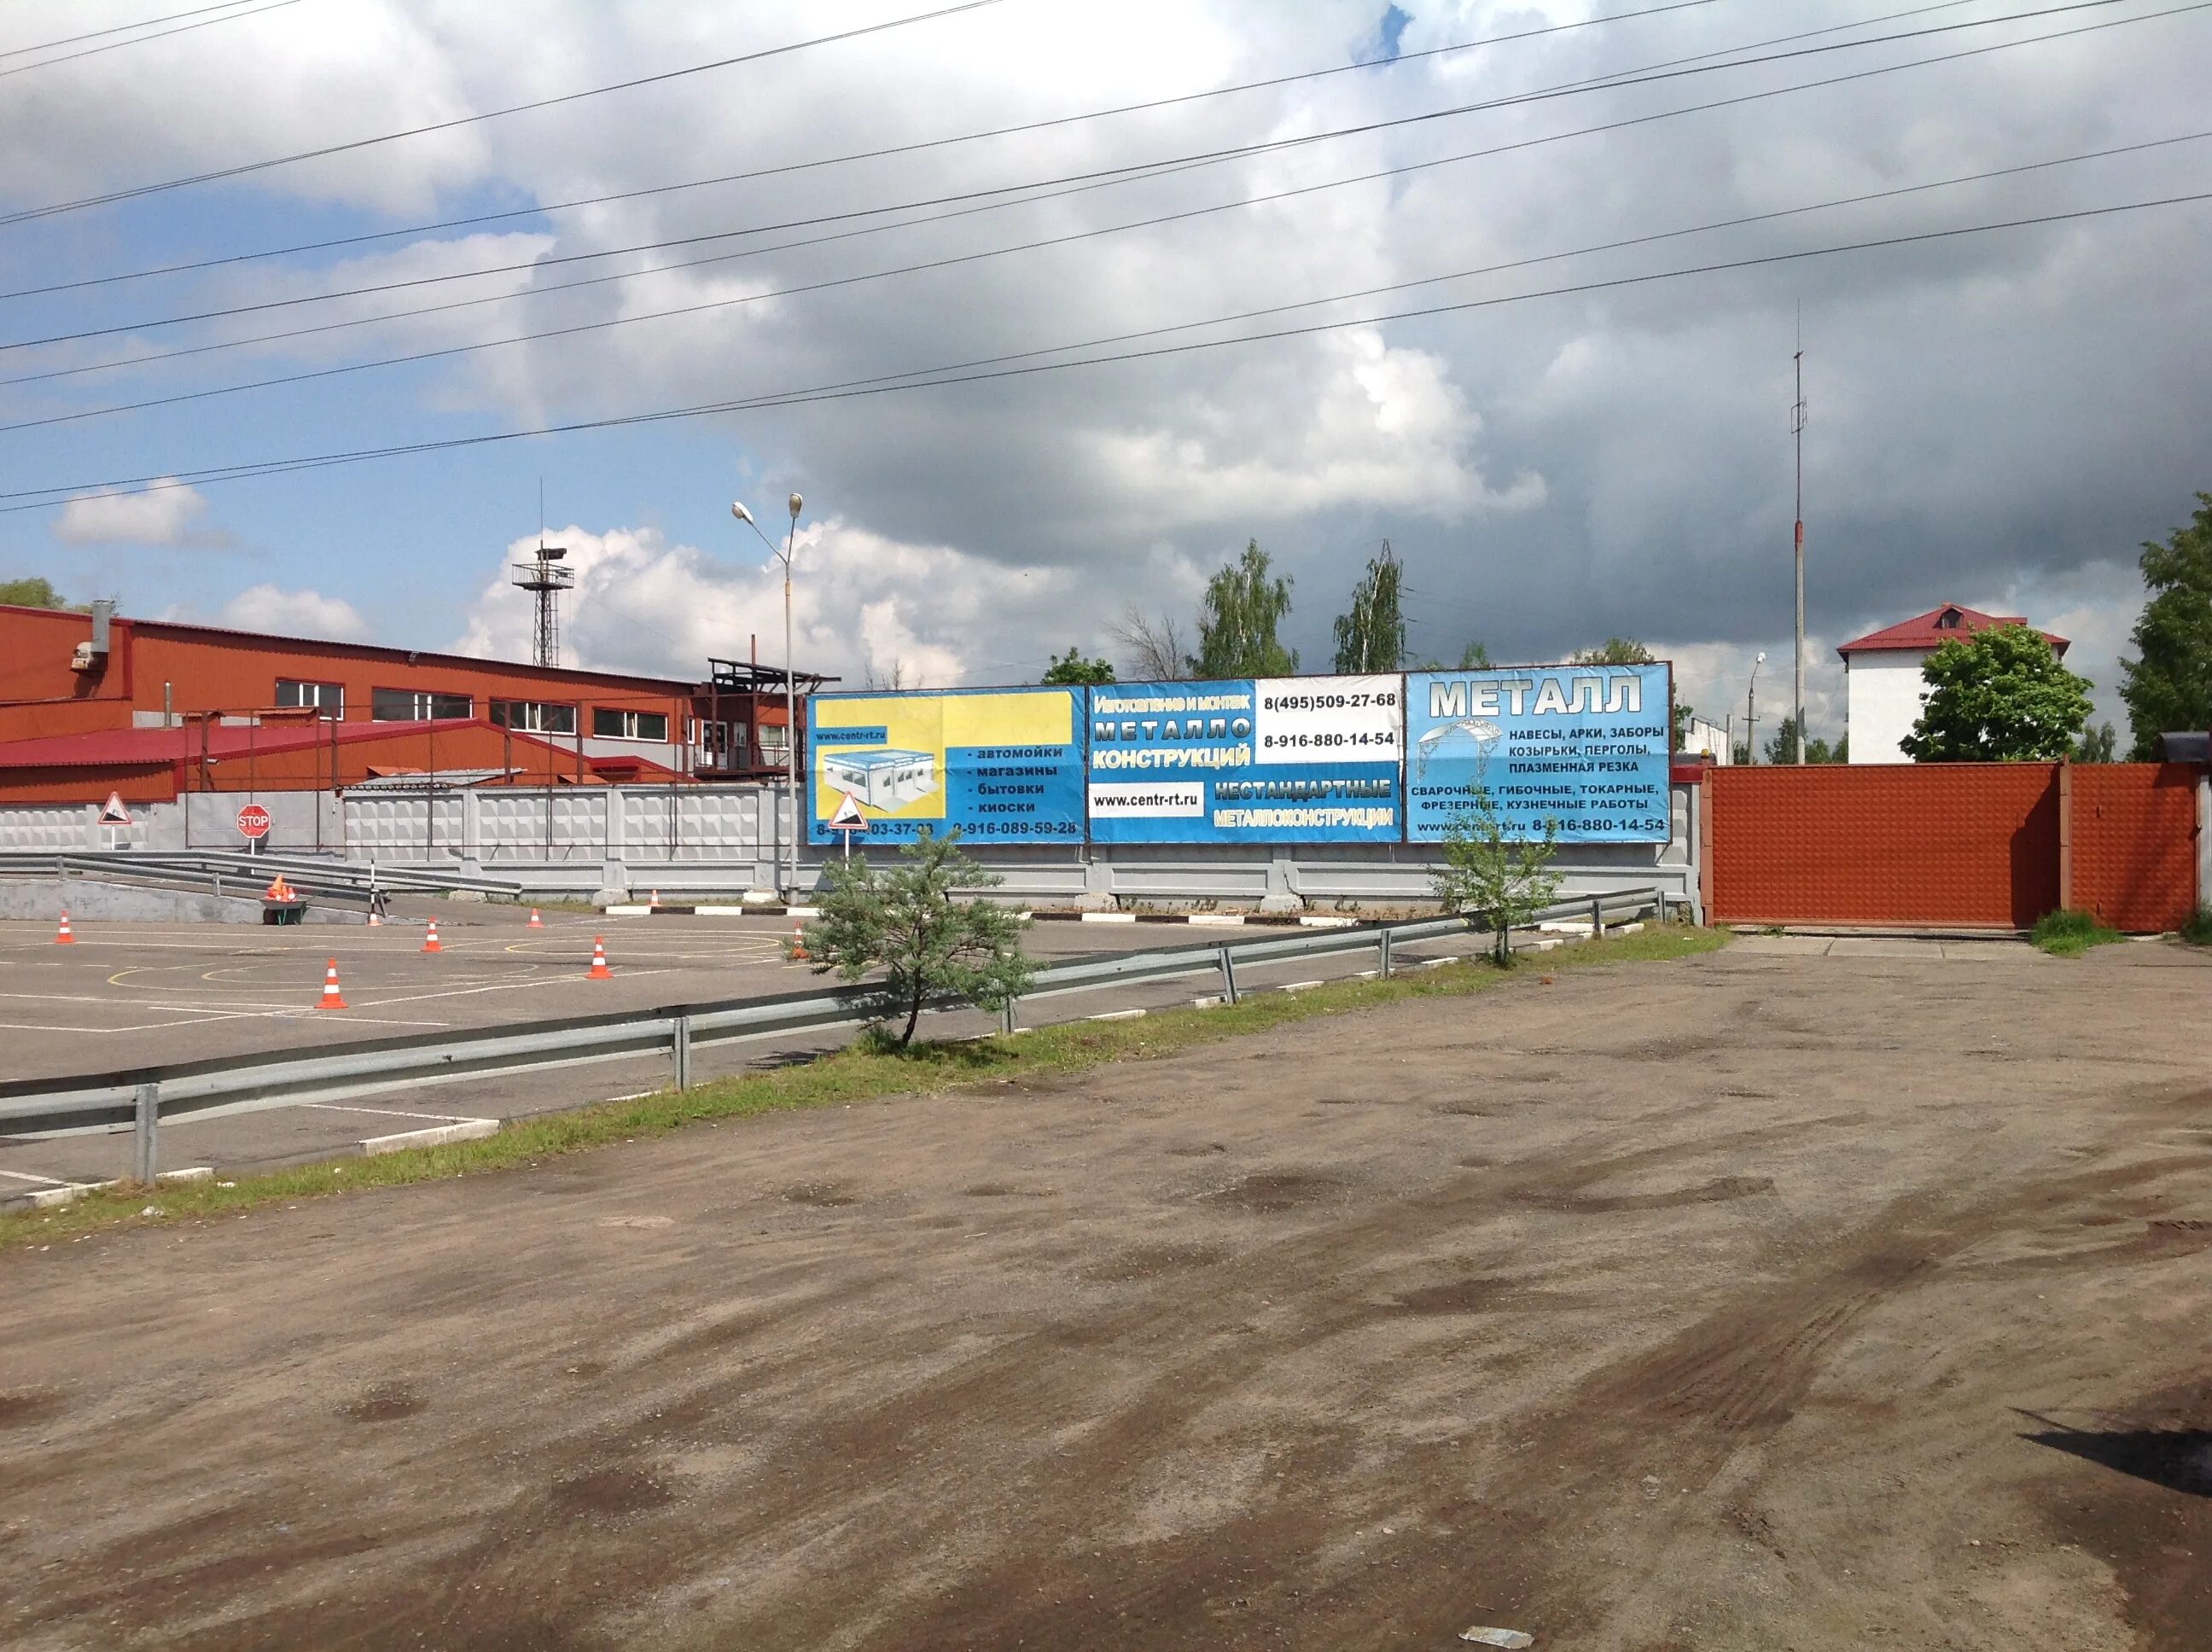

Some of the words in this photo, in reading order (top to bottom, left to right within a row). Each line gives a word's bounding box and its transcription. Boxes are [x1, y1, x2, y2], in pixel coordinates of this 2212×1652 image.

[1264, 693, 1396, 713] 8(495)509-27-68
[1429, 675, 1642, 718] МЕТАЛЛ
[1094, 695, 1185, 713] Изготовление
[1187, 697, 1195, 711] и
[1197, 695, 1250, 710] монтаж
[816, 731, 886, 741] www.centr-rt.ru
[1095, 718, 1251, 742] МЕТАЛЛО
[1509, 728, 1566, 741] НАВЕСЫ,
[1569, 728, 1607, 740] АРКИ,
[1610, 726, 1664, 738] ЗАБОРЫ
[1264, 732, 1394, 748] 8-916-880-14-54
[977, 745, 1062, 759] автомойки
[1092, 742, 1251, 770] КОНСТРУКЦИЙ
[1585, 744, 1650, 756] ПЕРГОЛЫ,
[977, 766, 1057, 777] магазины
[1509, 762, 1595, 774] ПЛАЗМЕННАЯ
[1598, 761, 1639, 772] РЕЗКА
[978, 782, 1045, 795] бытовки
[1214, 779, 1392, 803] НЕСТАНДАРТНЫЕ
[1499, 785, 1576, 796] ГИБОЧНЫЕ,
[1580, 784, 1659, 794] ТОКАРНЫЕ,
[1094, 793, 1198, 807] www.centr-rt.ru
[1506, 800, 1586, 810] КУЗНЕЧНЫЕ
[1591, 800, 1649, 809] РАБОТЫ
[979, 803, 1035, 812] киоски
[238, 816, 269, 827] STOP
[1214, 807, 1394, 829] МЕТАЛЛОКОНСТРУКЦИИ
[1533, 818, 1665, 831] 8-16-880-14-54
